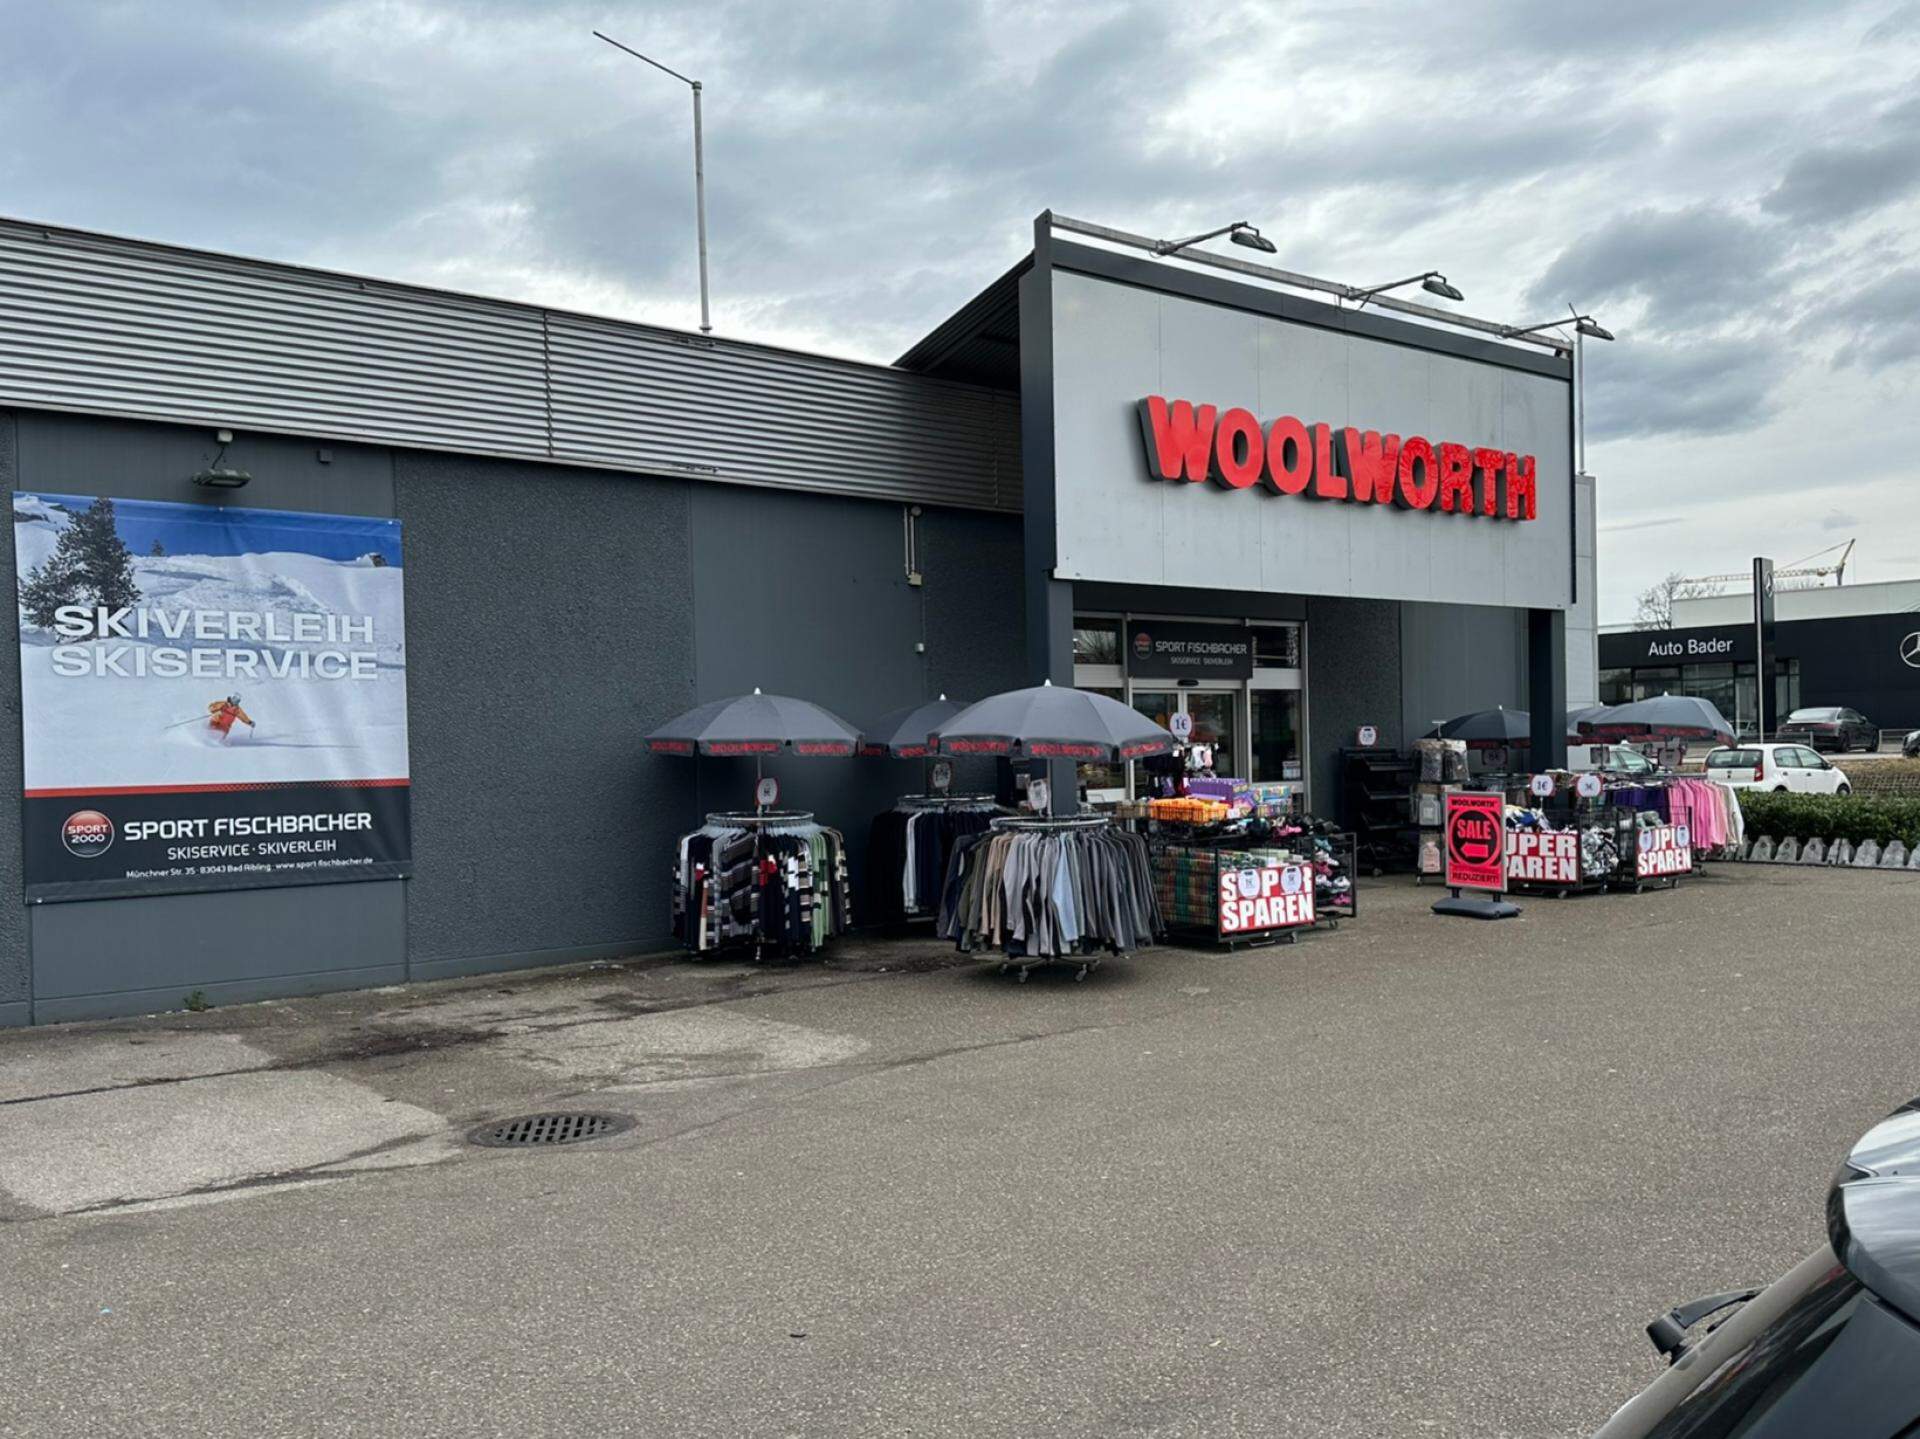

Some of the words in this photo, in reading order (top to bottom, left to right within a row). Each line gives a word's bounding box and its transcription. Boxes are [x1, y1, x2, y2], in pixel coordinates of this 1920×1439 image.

[1140, 395, 1536, 521] WOOLWORTH
[54, 605, 374, 643] SKIVERLEIH
[1155, 640, 1186, 652] SPORT
[1187, 642, 1247, 655] FISCHBACHER
[1648, 639, 1684, 656] Auto
[1687, 638, 1733, 654] Bader
[52, 647, 379, 680] SKISERVICE
[67, 824, 108, 834] SPORT
[124, 819, 209, 841] SPORT
[214, 812, 372, 837] FISCHBACHER
[1457, 819, 1491, 840] SALE
[71, 834, 105, 844] 2000
[167, 844, 250, 860] SKISERVICE
[258, 839, 337, 855] SKIVERLEIH
[126, 868, 169, 879] Münchner
[227, 863, 243, 873] Bad
[1638, 847, 1692, 875] SPAREN
[1222, 894, 1315, 930] SPAREN
